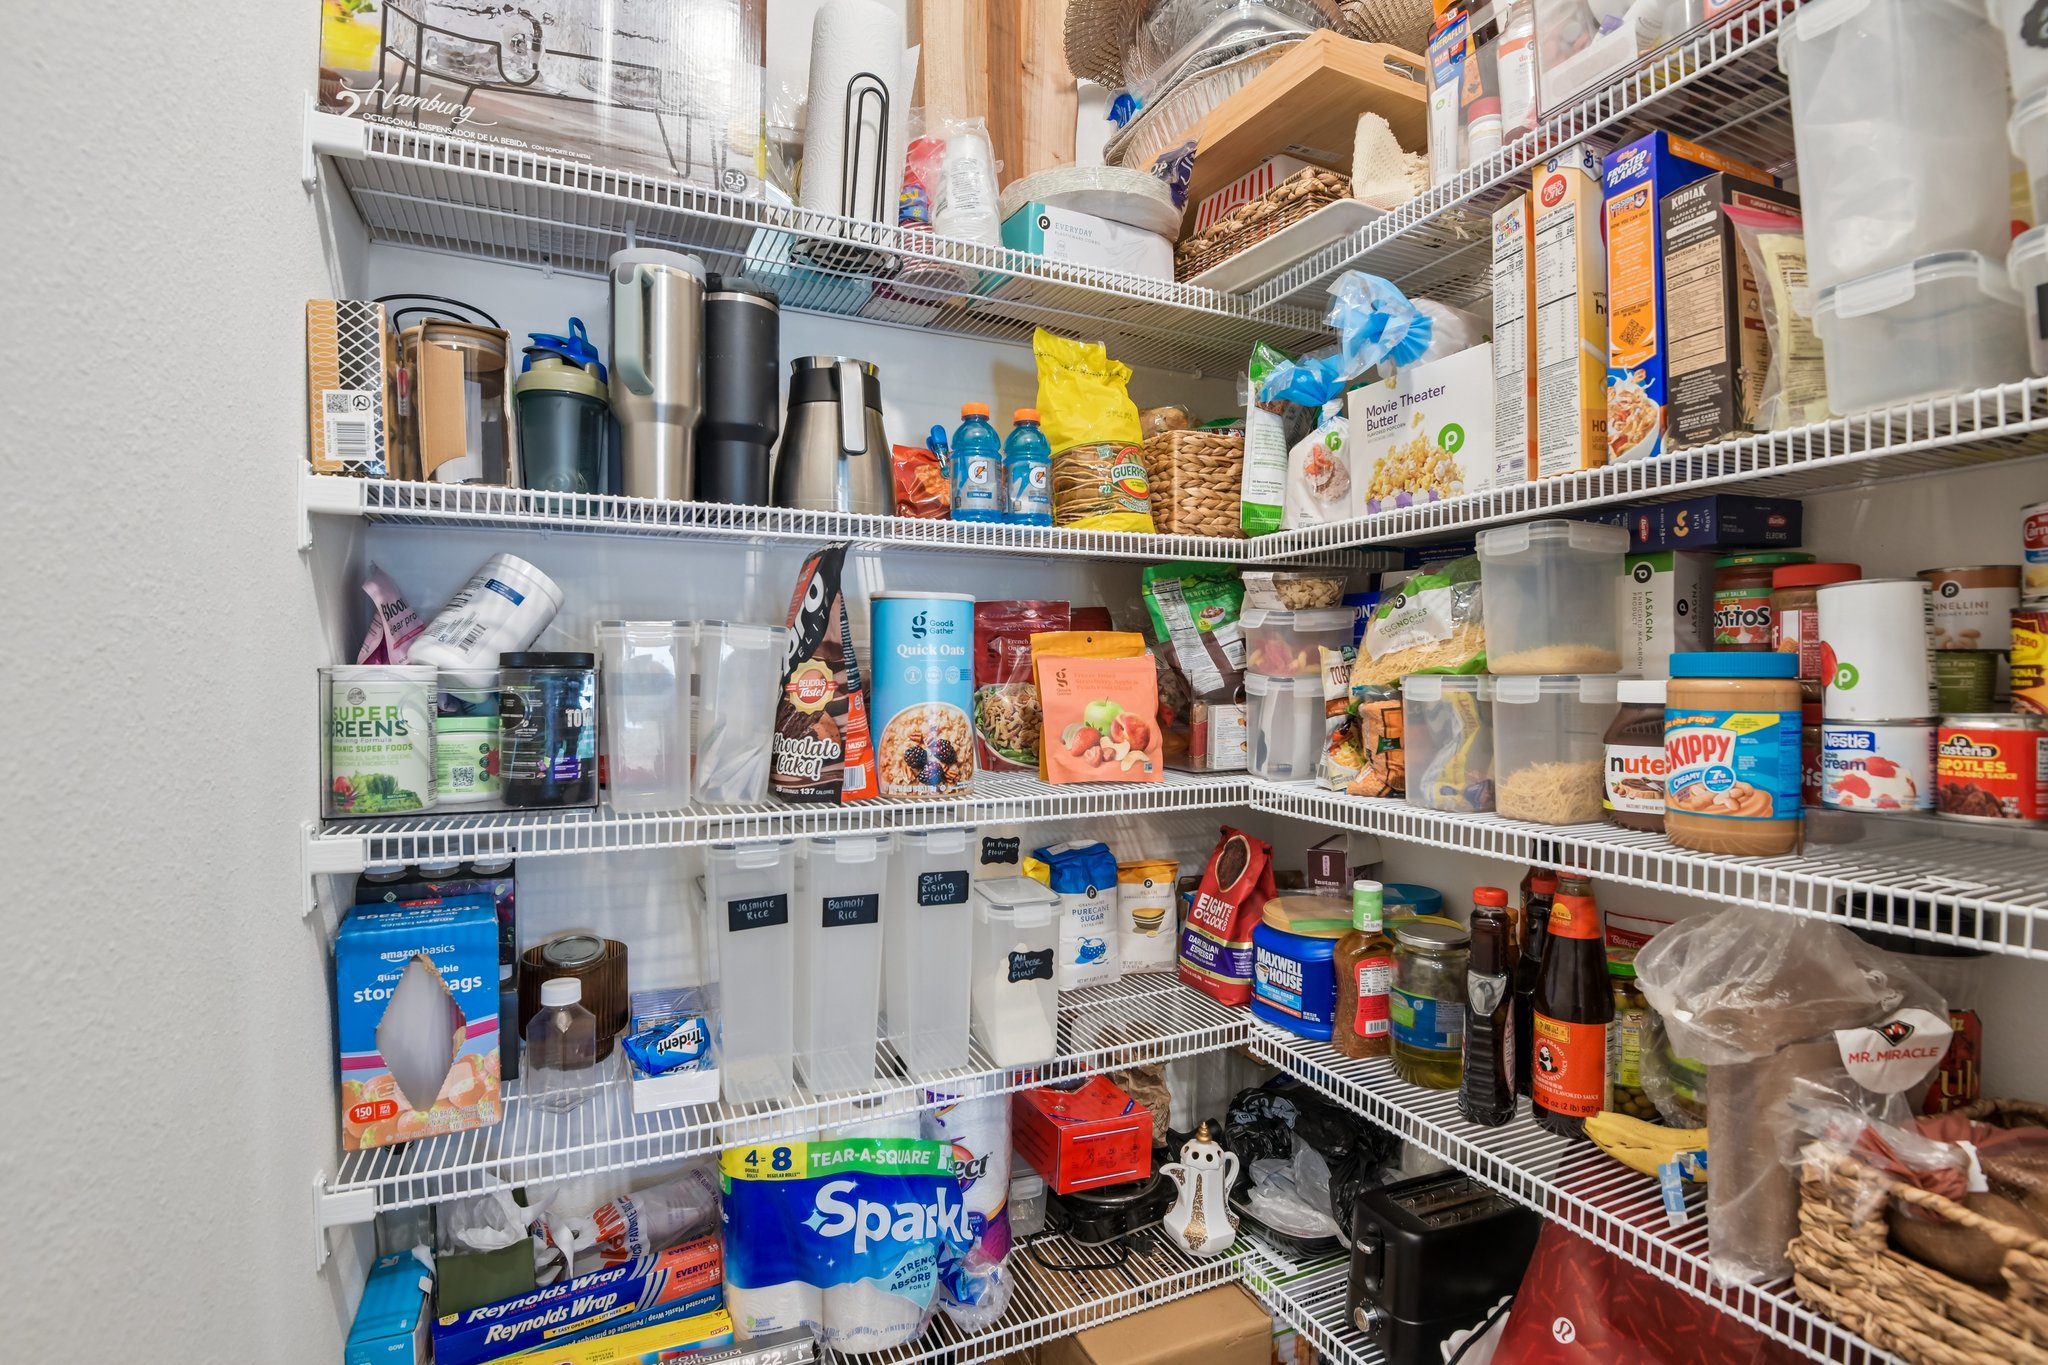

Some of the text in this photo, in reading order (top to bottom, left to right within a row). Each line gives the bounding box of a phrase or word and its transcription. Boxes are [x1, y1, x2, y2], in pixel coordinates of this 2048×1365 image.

[340, 79, 497, 126] Hamburg
[363, 112, 418, 129] OCTAGONAL
[420, 122, 476, 139] DISPENSADOR
[477, 132, 488, 141] DE
[489, 135, 500, 144] LA
[500, 137, 528, 149] BEBIDA
[532, 144, 544, 152] CON
[1607, 149, 1648, 182] FROSTED
[725, 171, 745, 187] 5.8
[1609, 163, 1643, 188] FLAKES
[1671, 183, 1708, 211] KODIAK
[1669, 206, 1696, 222] FLAPJACK
[1673, 213, 1696, 226] WAFFLE
[1056, 222, 1093, 238] EVERYDAY
[1666, 247, 1697, 262] Nutrition
[1698, 238, 1720, 249] Facts
[1704, 262, 1720, 275] 220
[1667, 275, 1694, 289] Calories
[1366, 384, 1446, 419] Movie Theater
[1367, 413, 1398, 432] Butter
[1765, 531, 1788, 540] ELBOWS
[1185, 588, 1213, 598] PERFECT
[1730, 589, 1748, 597] SALSA
[1645, 590, 1653, 642] LASAGNA
[929, 627, 954, 635] Gather
[896, 643, 966, 658] Quick Oats
[799, 686, 825, 699] Taste!
[333, 705, 399, 722] SUPER
[355, 743, 414, 753] SUPER FOODS
[773, 732, 841, 760] Chocolate
[1953, 736, 1968, 747] La
[1665, 733, 1731, 774] SKIPPY
[1938, 743, 1995, 758] Costeña
[776, 754, 823, 781] Cake!
[1610, 754, 1665, 776] nute
[1824, 757, 1867, 771] cream
[1673, 771, 1701, 789] CREAMY
[1955, 770, 2018, 780] ADOBO SAUCE
[800, 787, 815, 795] 137
[922, 873, 944, 885] Self
[1314, 878, 1340, 887] Instant
[922, 882, 955, 894] Rising
[737, 899, 775, 912] Jasmine
[828, 897, 865, 910] Basmati
[922, 892, 956, 903] Flour
[1197, 892, 1230, 919] EIGHT
[746, 909, 770, 921] Rice
[838, 910, 858, 921] Rice
[1080, 913, 1105, 923] SUGAR
[1193, 908, 1223, 931] O'CLOCK
[380, 944, 455, 962] amazon basics
[1014, 954, 1026, 962] All
[1257, 946, 1303, 978] MAXWELL
[1011, 967, 1036, 980] Flour
[1269, 967, 1303, 992] HOUSE
[353, 986, 395, 1003] stor
[657, 1028, 704, 1056] Trident
[1848, 1046, 1940, 1064] MR. MIRACLE
[1553, 1088, 1582, 1099] FLAVORED
[354, 1106, 373, 1118] 150
[1561, 1102, 1568, 1111] (2
[1569, 1102, 1580, 1112] lb)
[1581, 1105, 1594, 1113] 907
[744, 1146, 793, 1171] 4 8
[811, 1147, 931, 1168] TEAR-A-SQUARE
[815, 1180, 975, 1254] Sparkl
[626, 1209, 640, 1242] FAVORITE
[668, 1238, 712, 1256] EVERYDAY
[675, 1258, 718, 1279] EVERYDAY
[709, 1267, 720, 1276] 15
[894, 1254, 937, 1280] STRENG
[915, 1265, 929, 1274] AND
[588, 1281, 608, 1291] CLEAN
[890, 1271, 931, 1292] ABSORB
[908, 1283, 923, 1292] FOR
[466, 1267, 627, 1324] Reynolds Wrap
[648, 1308, 663, 1321] Wrap
[664, 1301, 684, 1317] Plastic
[483, 1291, 618, 1345] Reynolds Wrap
[557, 1326, 571, 1334] EASY
[571, 1321, 585, 1331] OPEN
[585, 1318, 595, 1326] TAB
[608, 1324, 618, 1335] de
